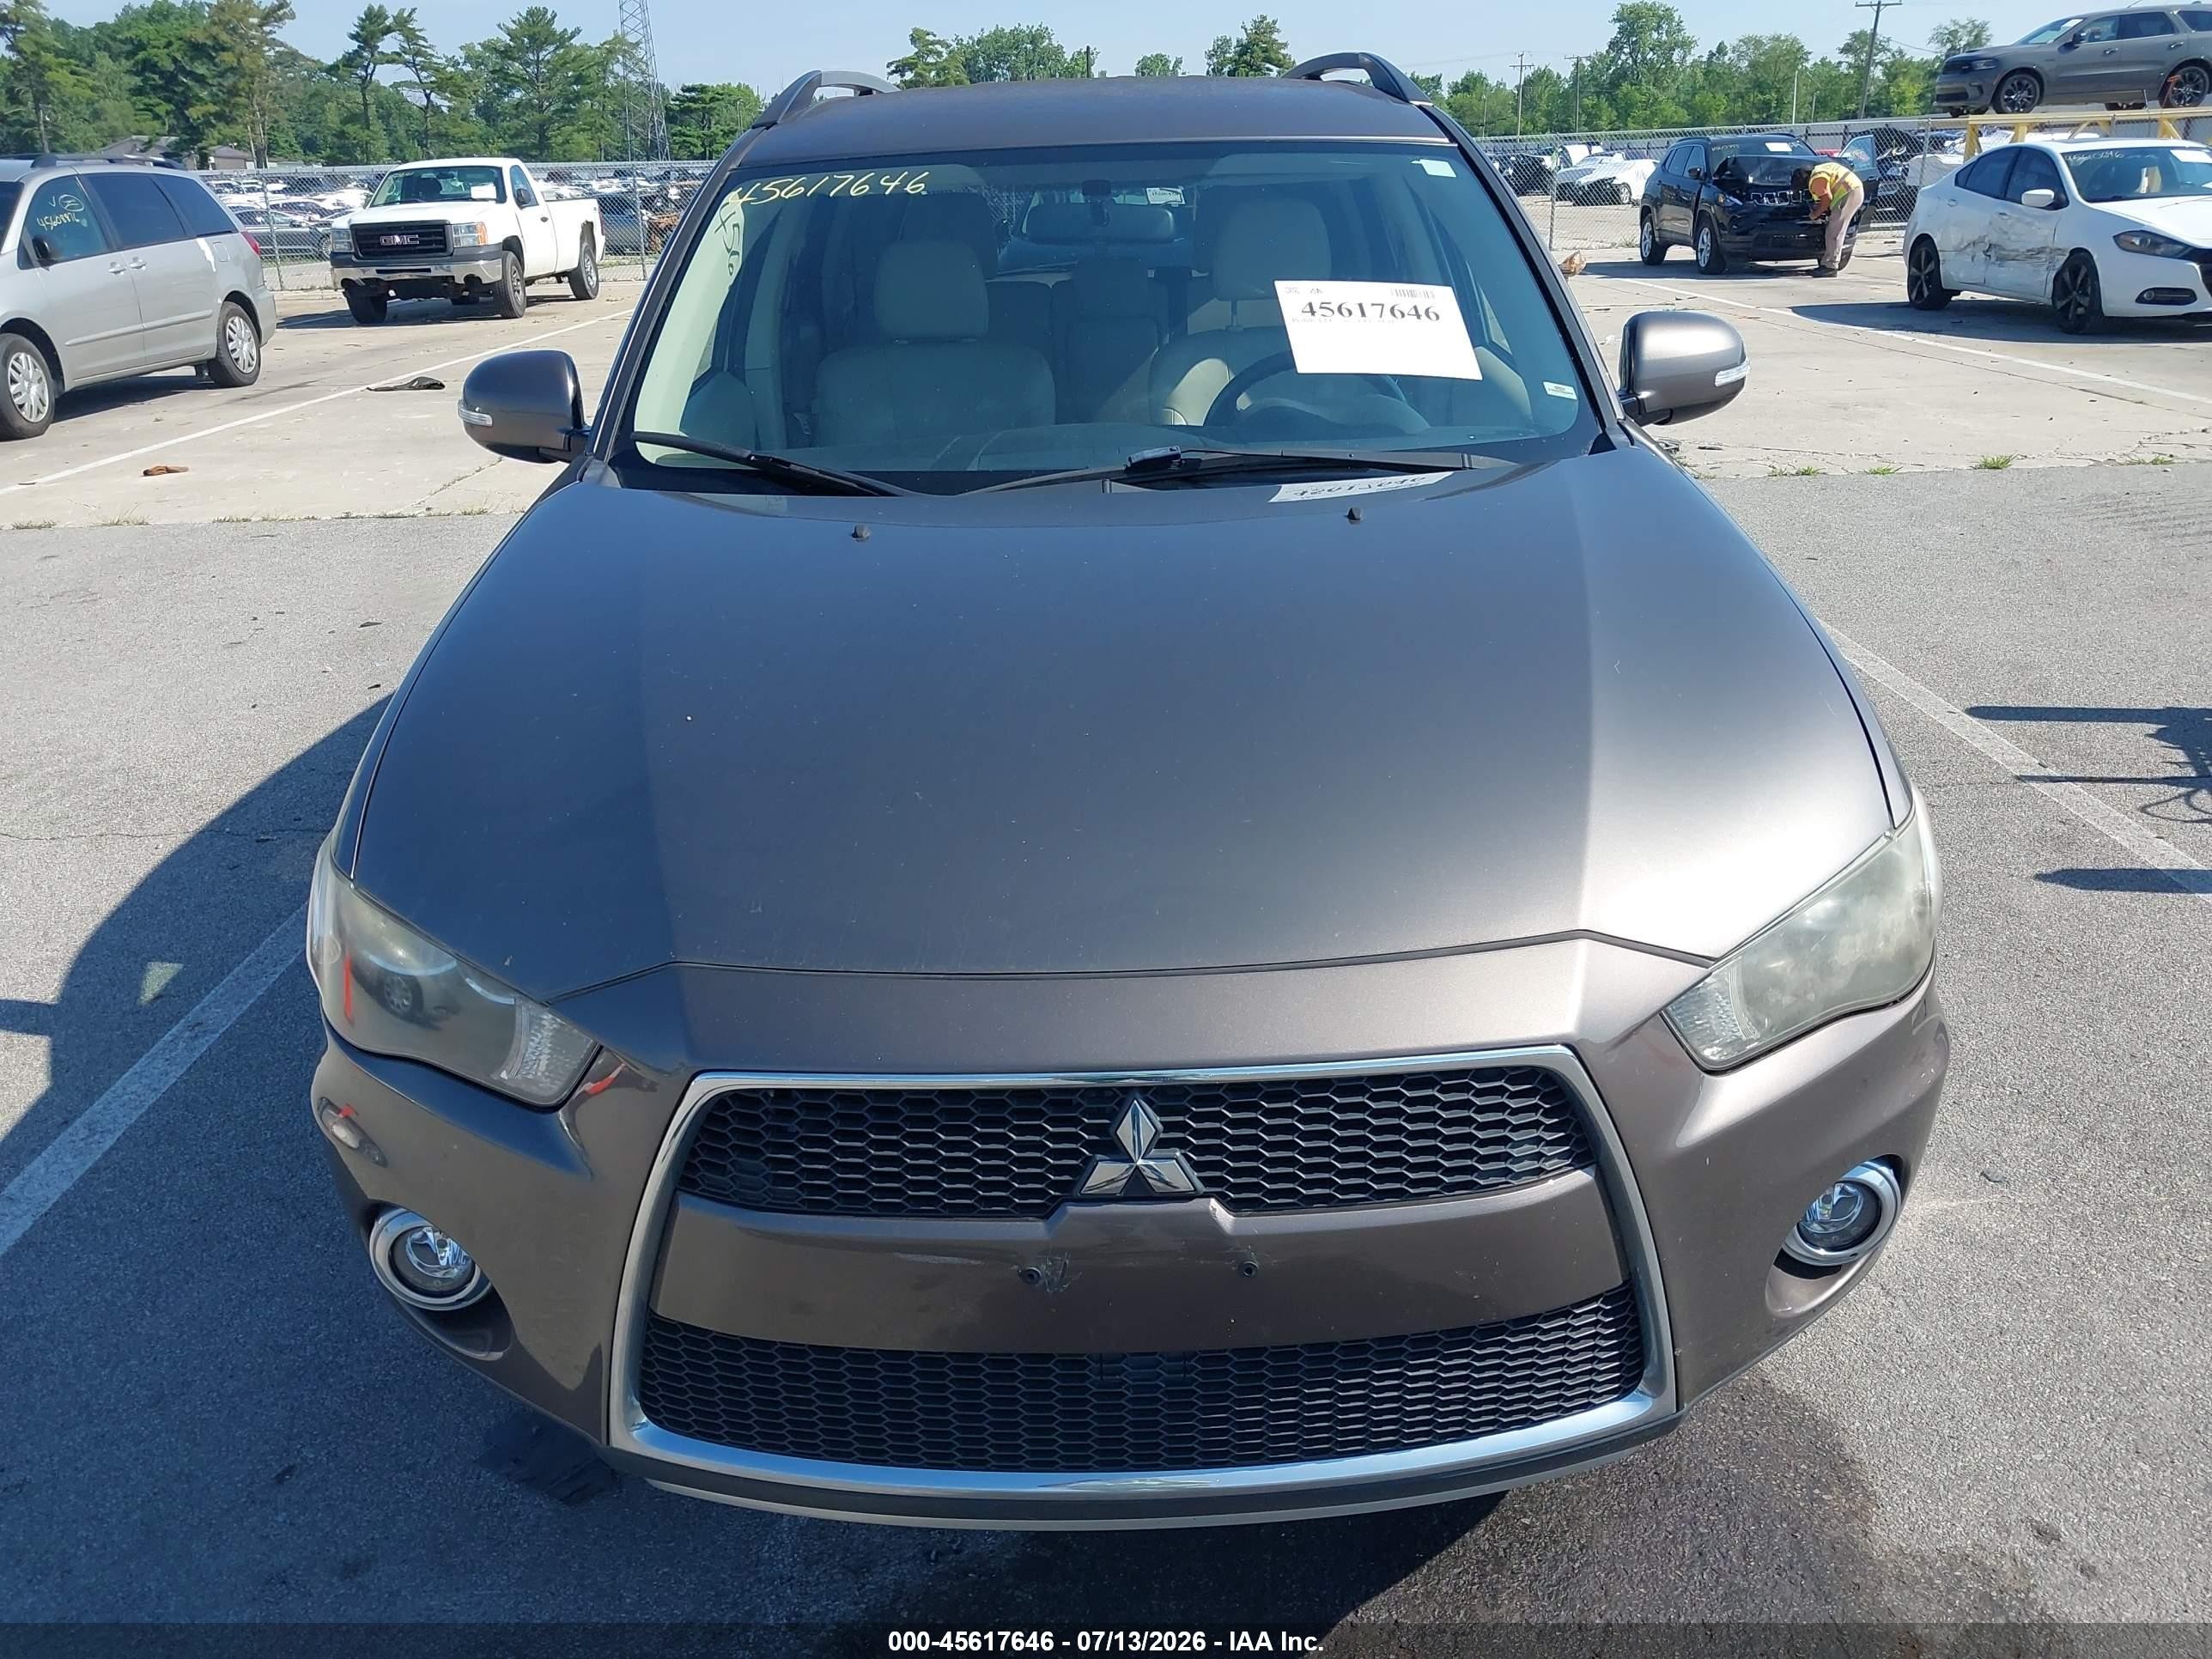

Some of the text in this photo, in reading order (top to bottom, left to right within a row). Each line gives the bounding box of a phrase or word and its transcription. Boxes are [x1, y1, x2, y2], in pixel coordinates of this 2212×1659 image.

[728, 171, 930, 205] 45617646
[380, 234, 420, 246] GMC
[1301, 301, 1441, 322] 45617646
